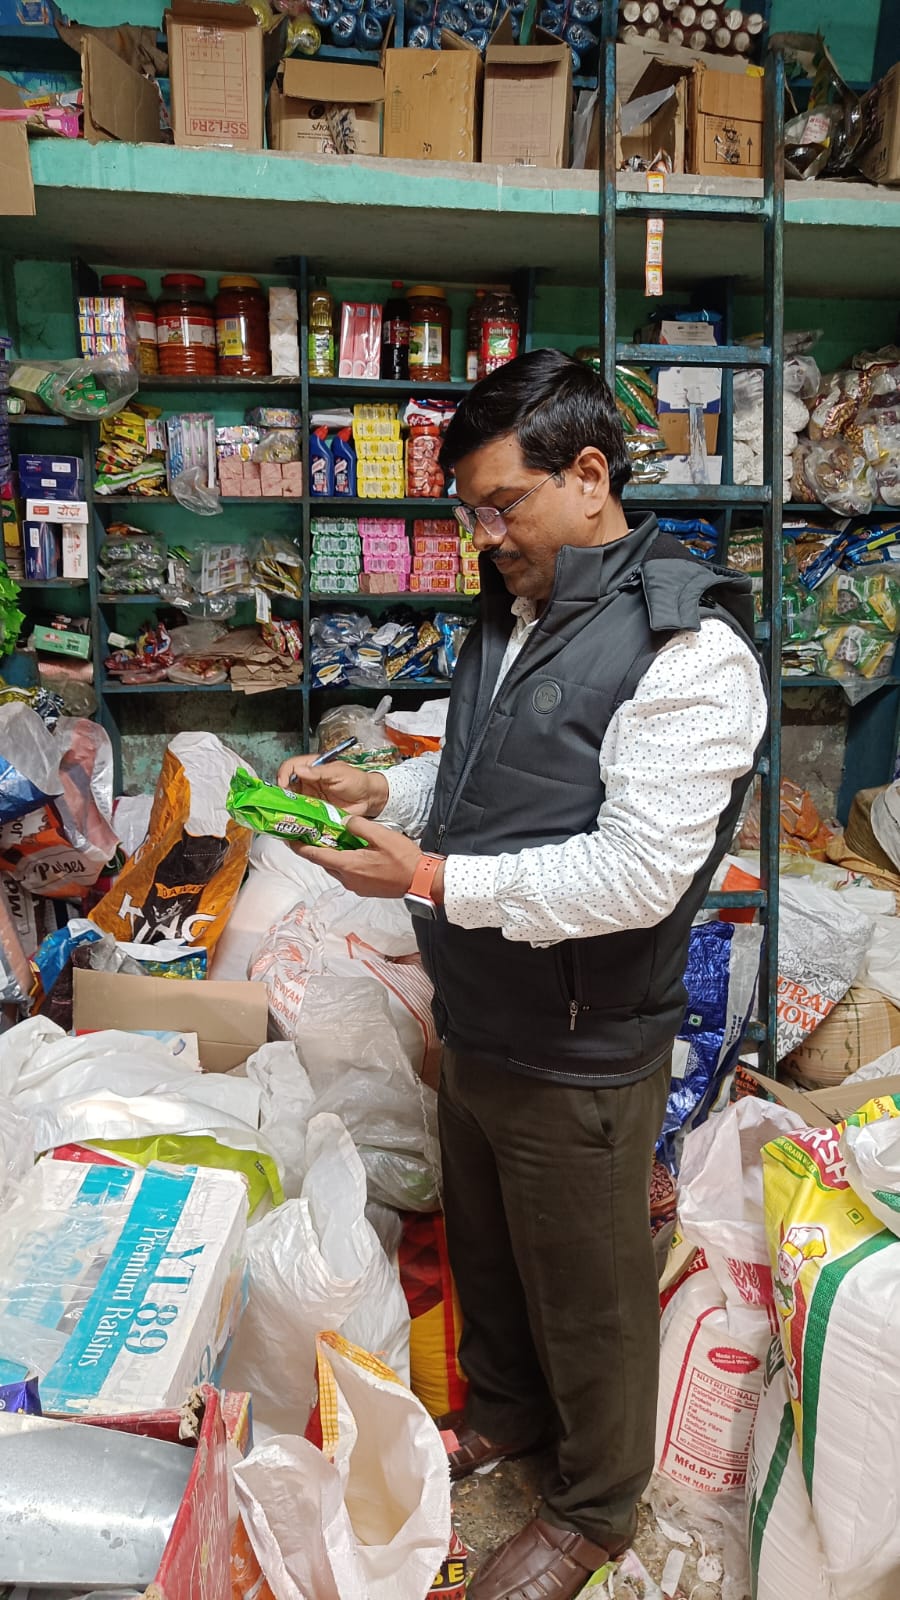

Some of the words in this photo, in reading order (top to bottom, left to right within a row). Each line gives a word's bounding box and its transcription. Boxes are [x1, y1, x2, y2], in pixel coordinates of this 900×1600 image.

[34, 860, 86, 880] Pulses
[112, 1226, 170, 1301] Premium
[78, 1306, 135, 1367] Raisins
[124, 1302, 178, 1355] 89
[696, 1373, 757, 1402] NUTRITIONAL
[675, 1453, 717, 1480] Mfd.By:
